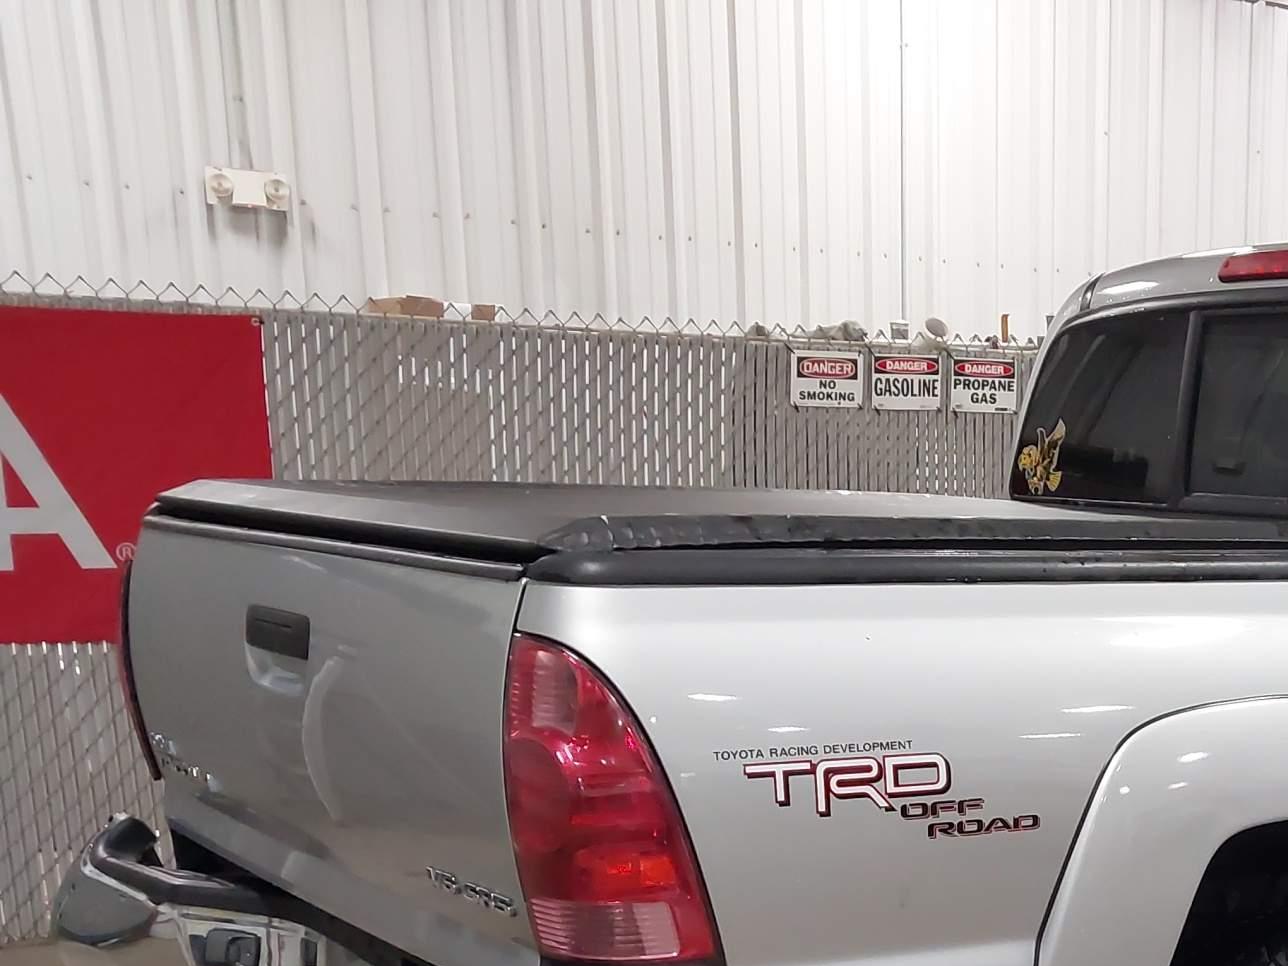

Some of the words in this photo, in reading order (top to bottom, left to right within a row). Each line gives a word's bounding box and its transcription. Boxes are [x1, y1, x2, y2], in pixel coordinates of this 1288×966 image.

[804, 361, 852, 375] DANGER
[886, 360, 928, 371] DANGER
[964, 364, 1004, 375] DANGER
[819, 380, 837, 389] NO
[874, 377, 939, 397] GASOLINE
[953, 378, 1015, 392] PROPANE
[799, 390, 855, 402] SMOKING
[970, 392, 997, 404] GAS
[713, 748, 765, 761] TOYOTA
[769, 745, 819, 758] RACING
[823, 740, 913, 755] DEVELOPMENT
[743, 752, 951, 817] TRD
[900, 798, 985, 821] OFF
[927, 814, 1041, 840] ROAD
